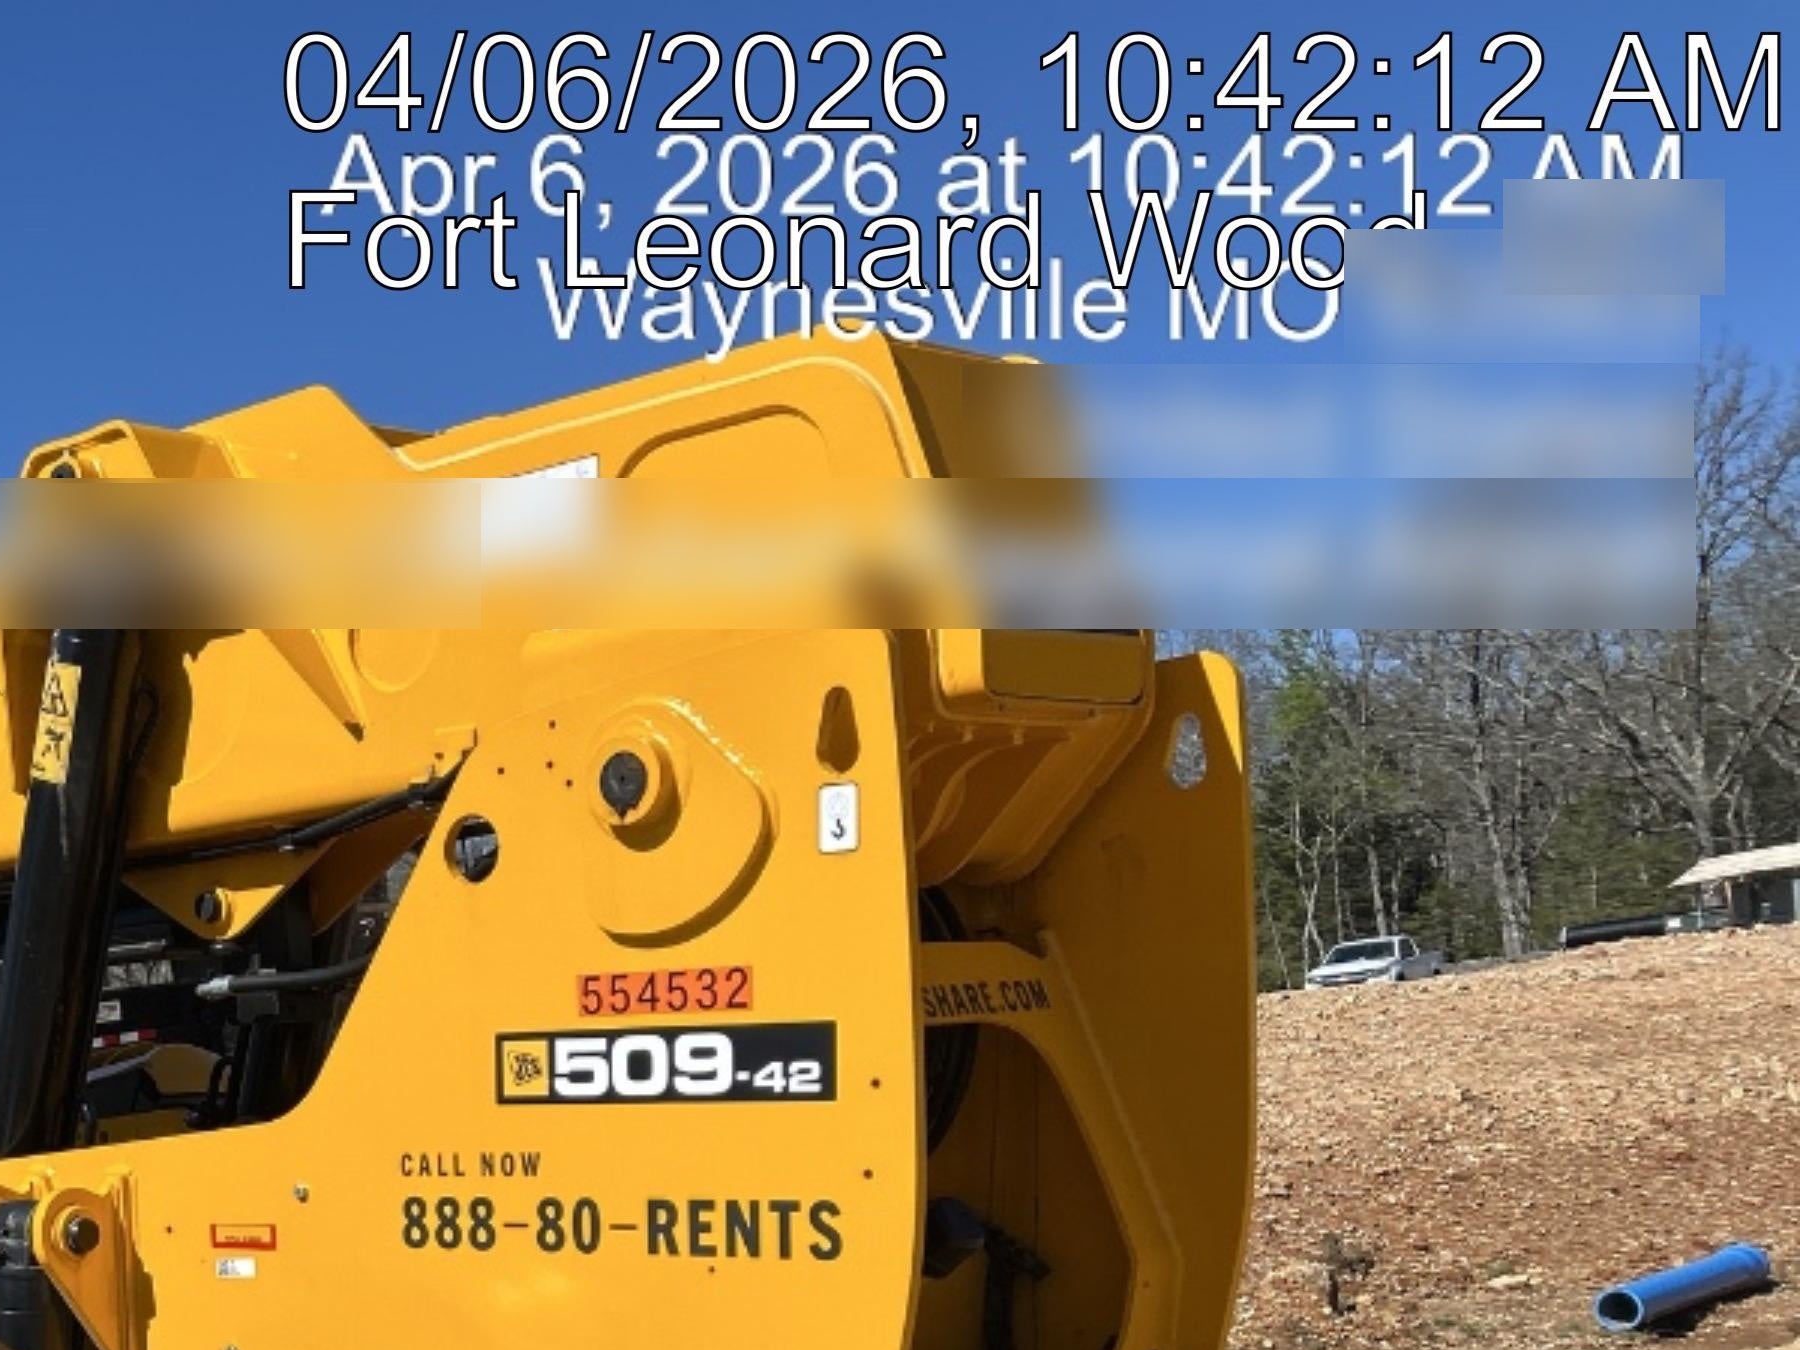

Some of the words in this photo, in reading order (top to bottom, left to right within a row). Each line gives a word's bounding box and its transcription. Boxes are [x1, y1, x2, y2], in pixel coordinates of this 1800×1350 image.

[580, 966, 749, 1015] 554532
[553, 1031, 823, 1096] 509-42
[400, 1152, 466, 1178] CALL
[480, 1152, 541, 1178] NOW
[402, 1196, 843, 1261] 888-80-RENTS
